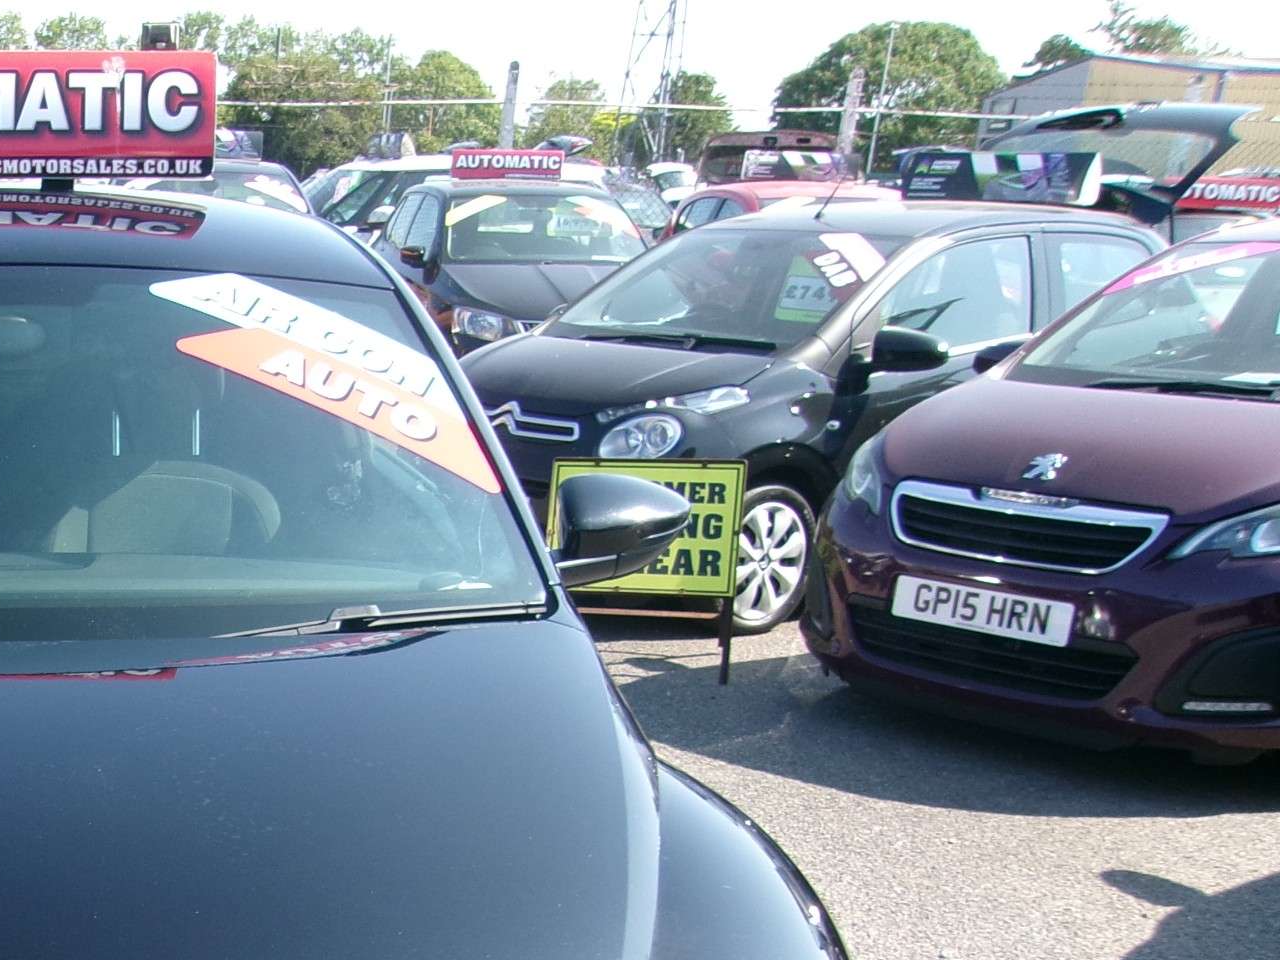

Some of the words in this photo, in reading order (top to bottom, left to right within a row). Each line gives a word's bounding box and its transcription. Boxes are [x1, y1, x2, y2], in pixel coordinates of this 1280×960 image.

[455, 154, 561, 170] AUTOMATIC
[1181, 182, 1280, 203] TOMATIC
[191, 284, 300, 334] AIR
[320, 328, 436, 398] CON
[257, 349, 439, 442] AUTO
[641, 548, 722, 577] EAR
[913, 583, 981, 622] GP15
[985, 595, 1053, 635] HRN
